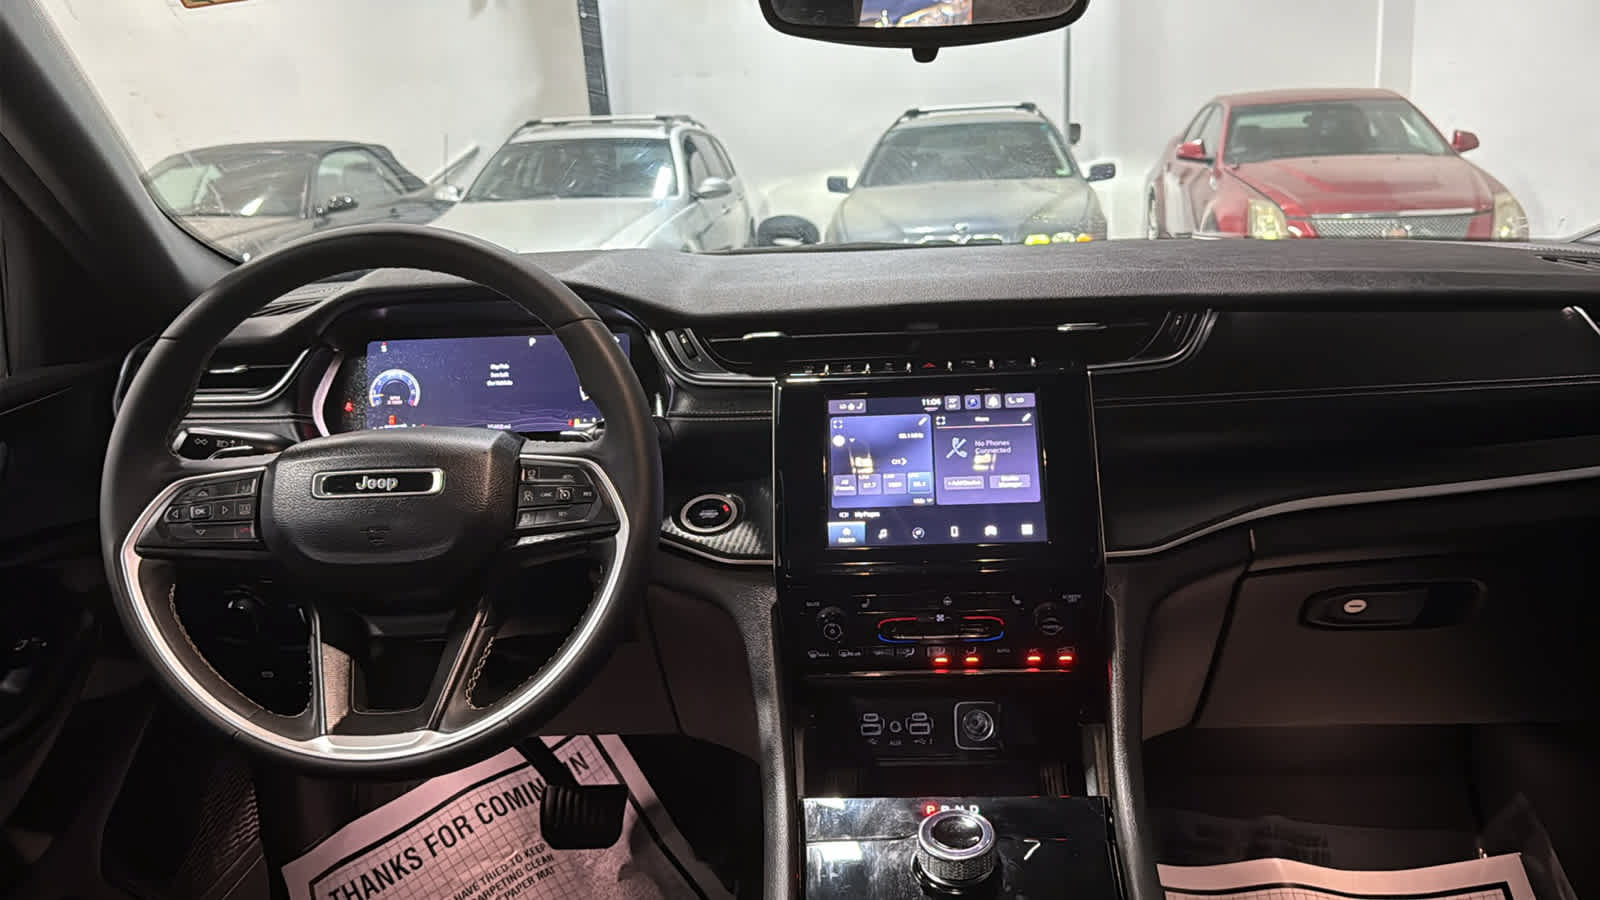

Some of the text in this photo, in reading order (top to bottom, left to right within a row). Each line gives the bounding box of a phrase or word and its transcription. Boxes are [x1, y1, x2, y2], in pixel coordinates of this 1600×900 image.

[975, 447, 1012, 455] Connected
[355, 475, 399, 492] Jeep
[926, 805, 936, 815] P
[328, 846, 423, 900] THANKS
[423, 832, 474, 858] FOR
[474, 778, 547, 825] COMIN
[472, 853, 556, 900] ARPETING CLEAN
[480, 863, 509, 886] TRIED
[510, 853, 523, 867] TO
[524, 842, 547, 859] KEEP
[503, 865, 556, 900] PAPER MAT
